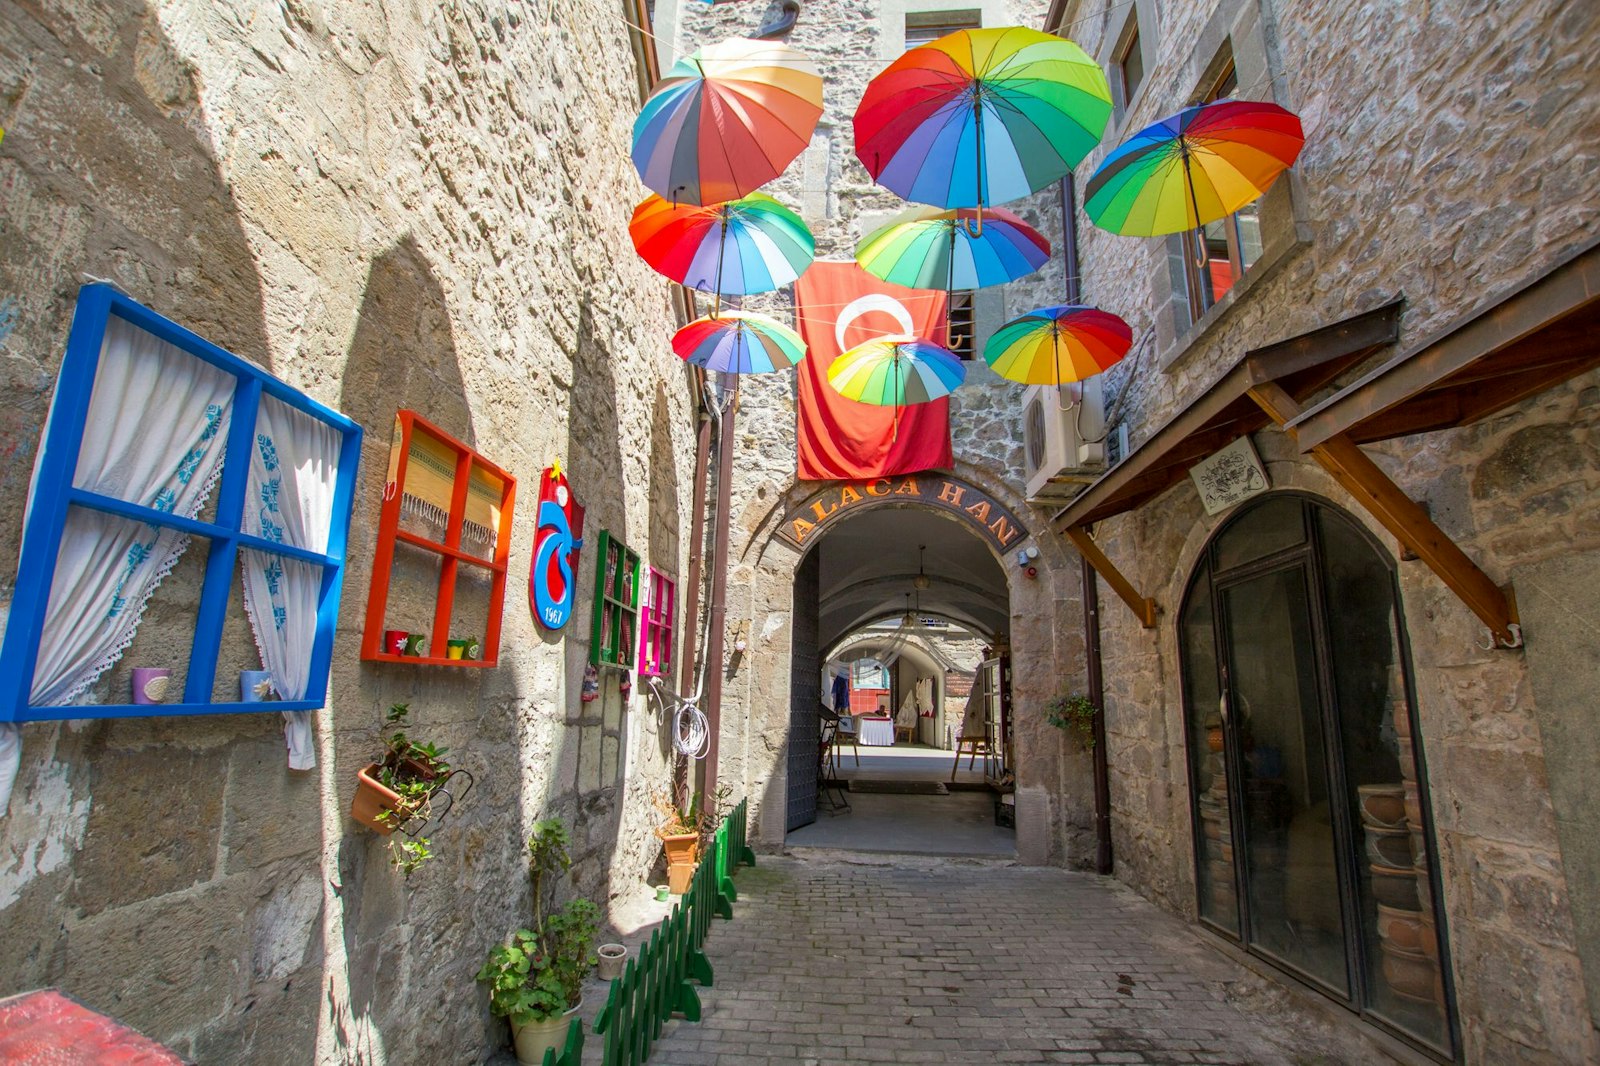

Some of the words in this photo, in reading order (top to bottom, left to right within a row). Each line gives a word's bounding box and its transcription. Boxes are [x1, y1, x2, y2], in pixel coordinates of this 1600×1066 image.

[792, 477, 921, 542] ALACA
[937, 481, 1019, 546] HAN
[545, 606, 563, 624] 1967
